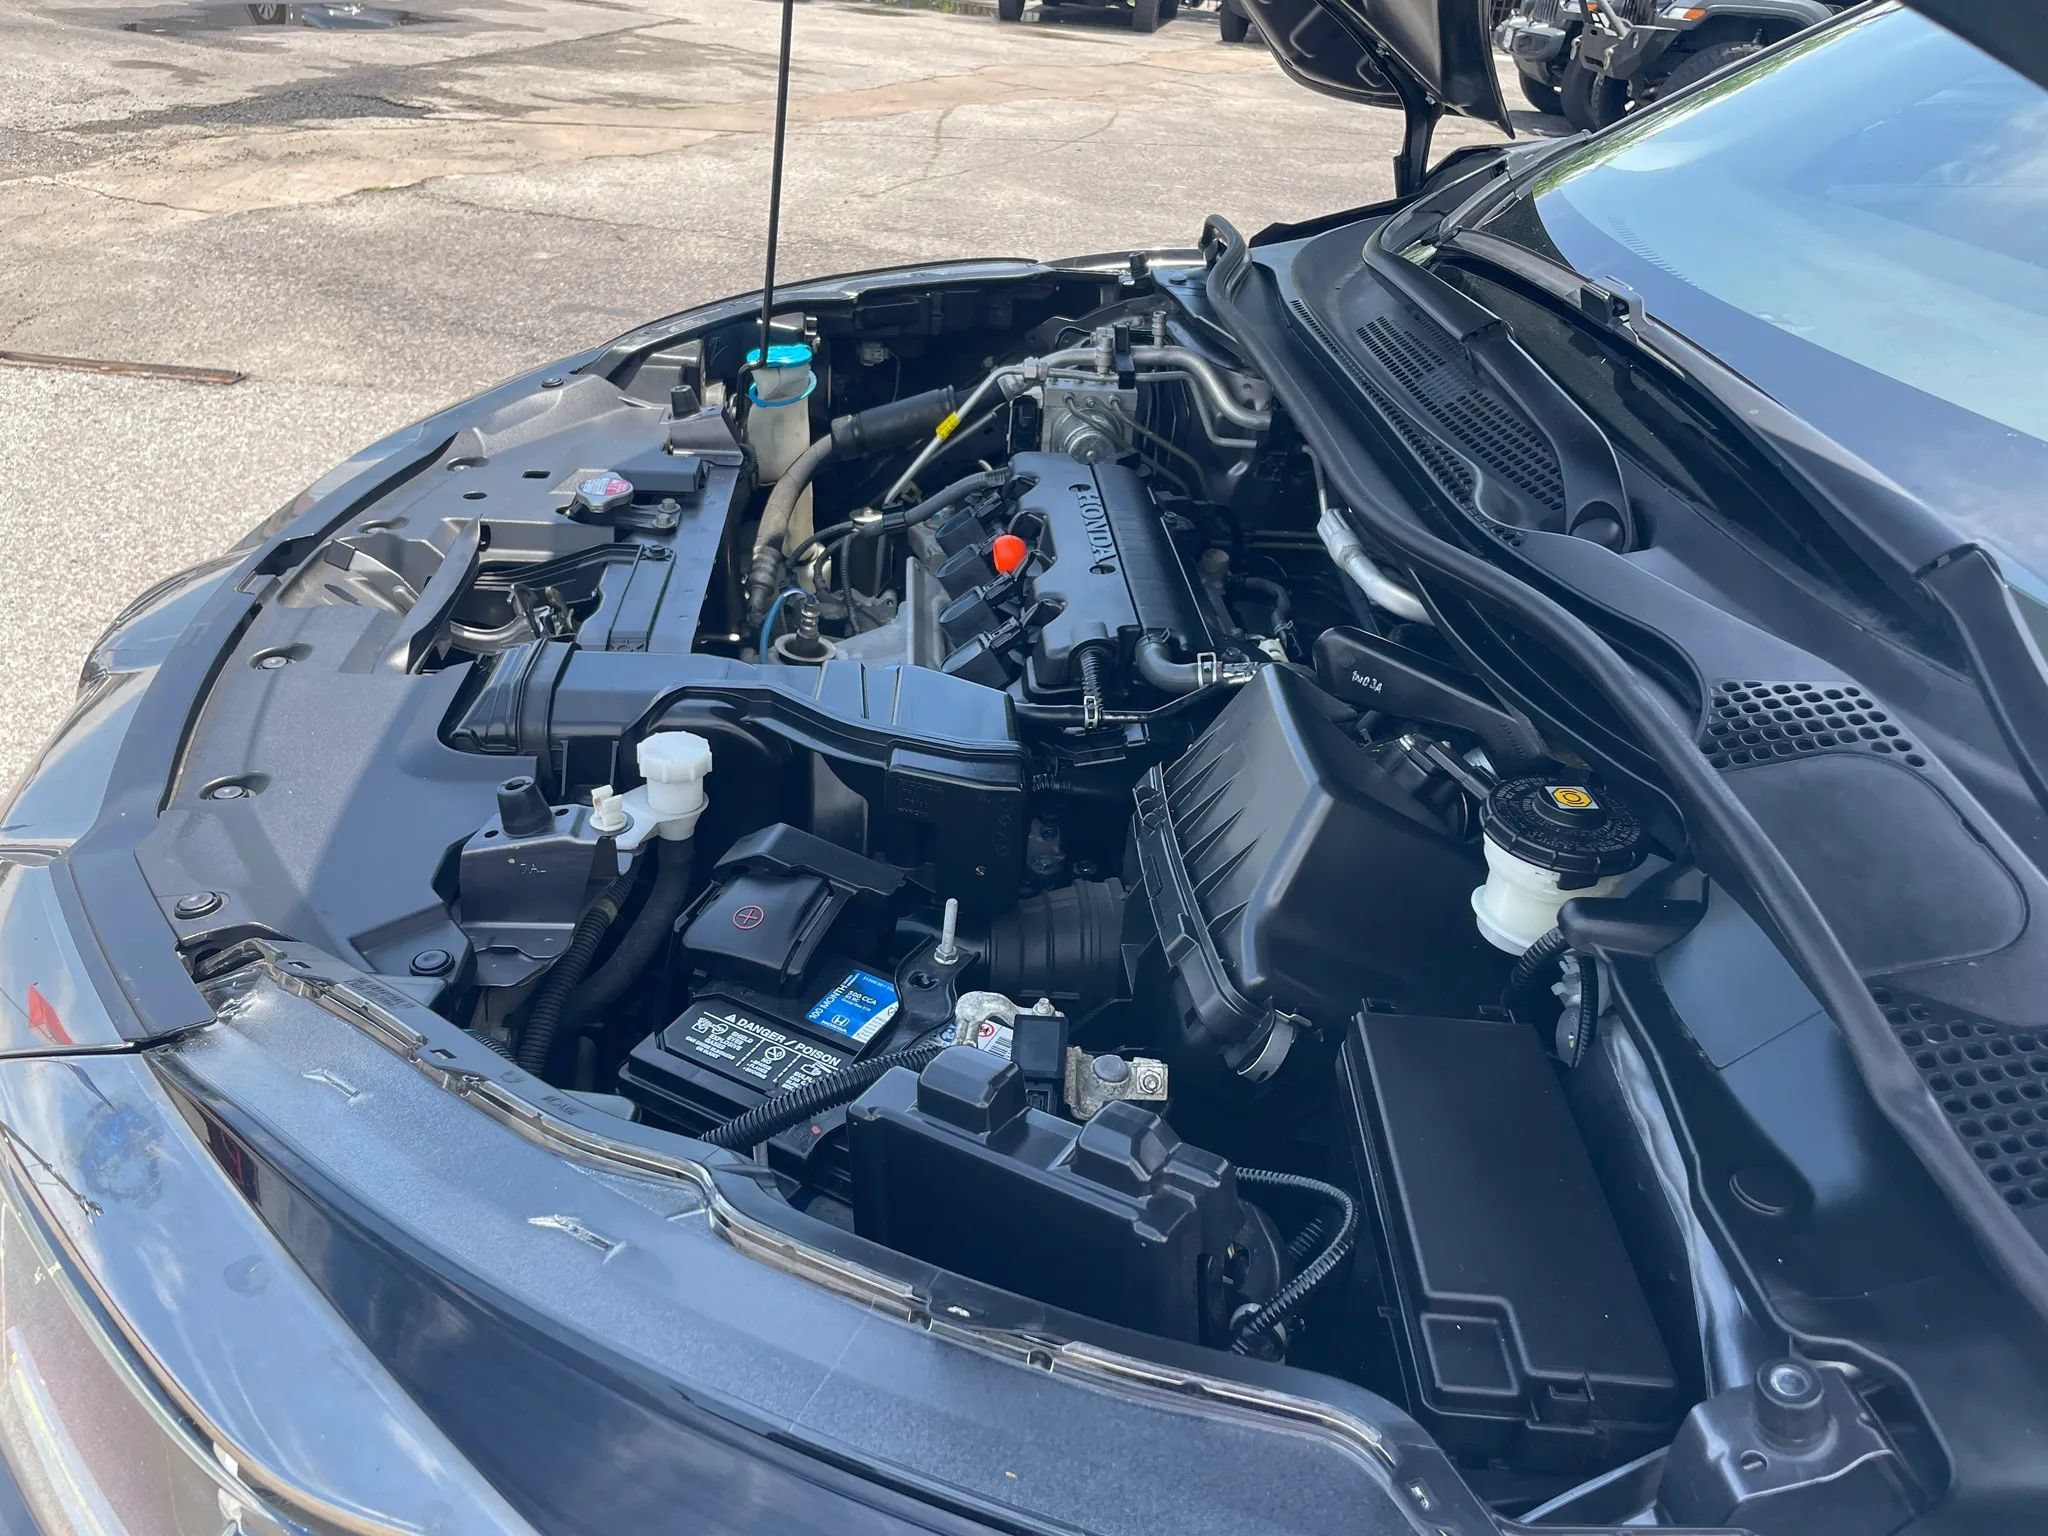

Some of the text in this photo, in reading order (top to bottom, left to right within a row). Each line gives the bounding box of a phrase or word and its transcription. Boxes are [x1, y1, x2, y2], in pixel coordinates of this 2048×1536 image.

[1077, 494, 1117, 565] HONDA
[809, 984, 848, 1019] 100 MONTH
[861, 995, 877, 1006] CCA
[821, 1019, 848, 1033] HONDA
[708, 1033, 743, 1051] EXPLOSIVE
[731, 1031, 754, 1044] SHIELD
[736, 1018, 787, 1043] DANGER
[794, 1043, 841, 1067] POISON
